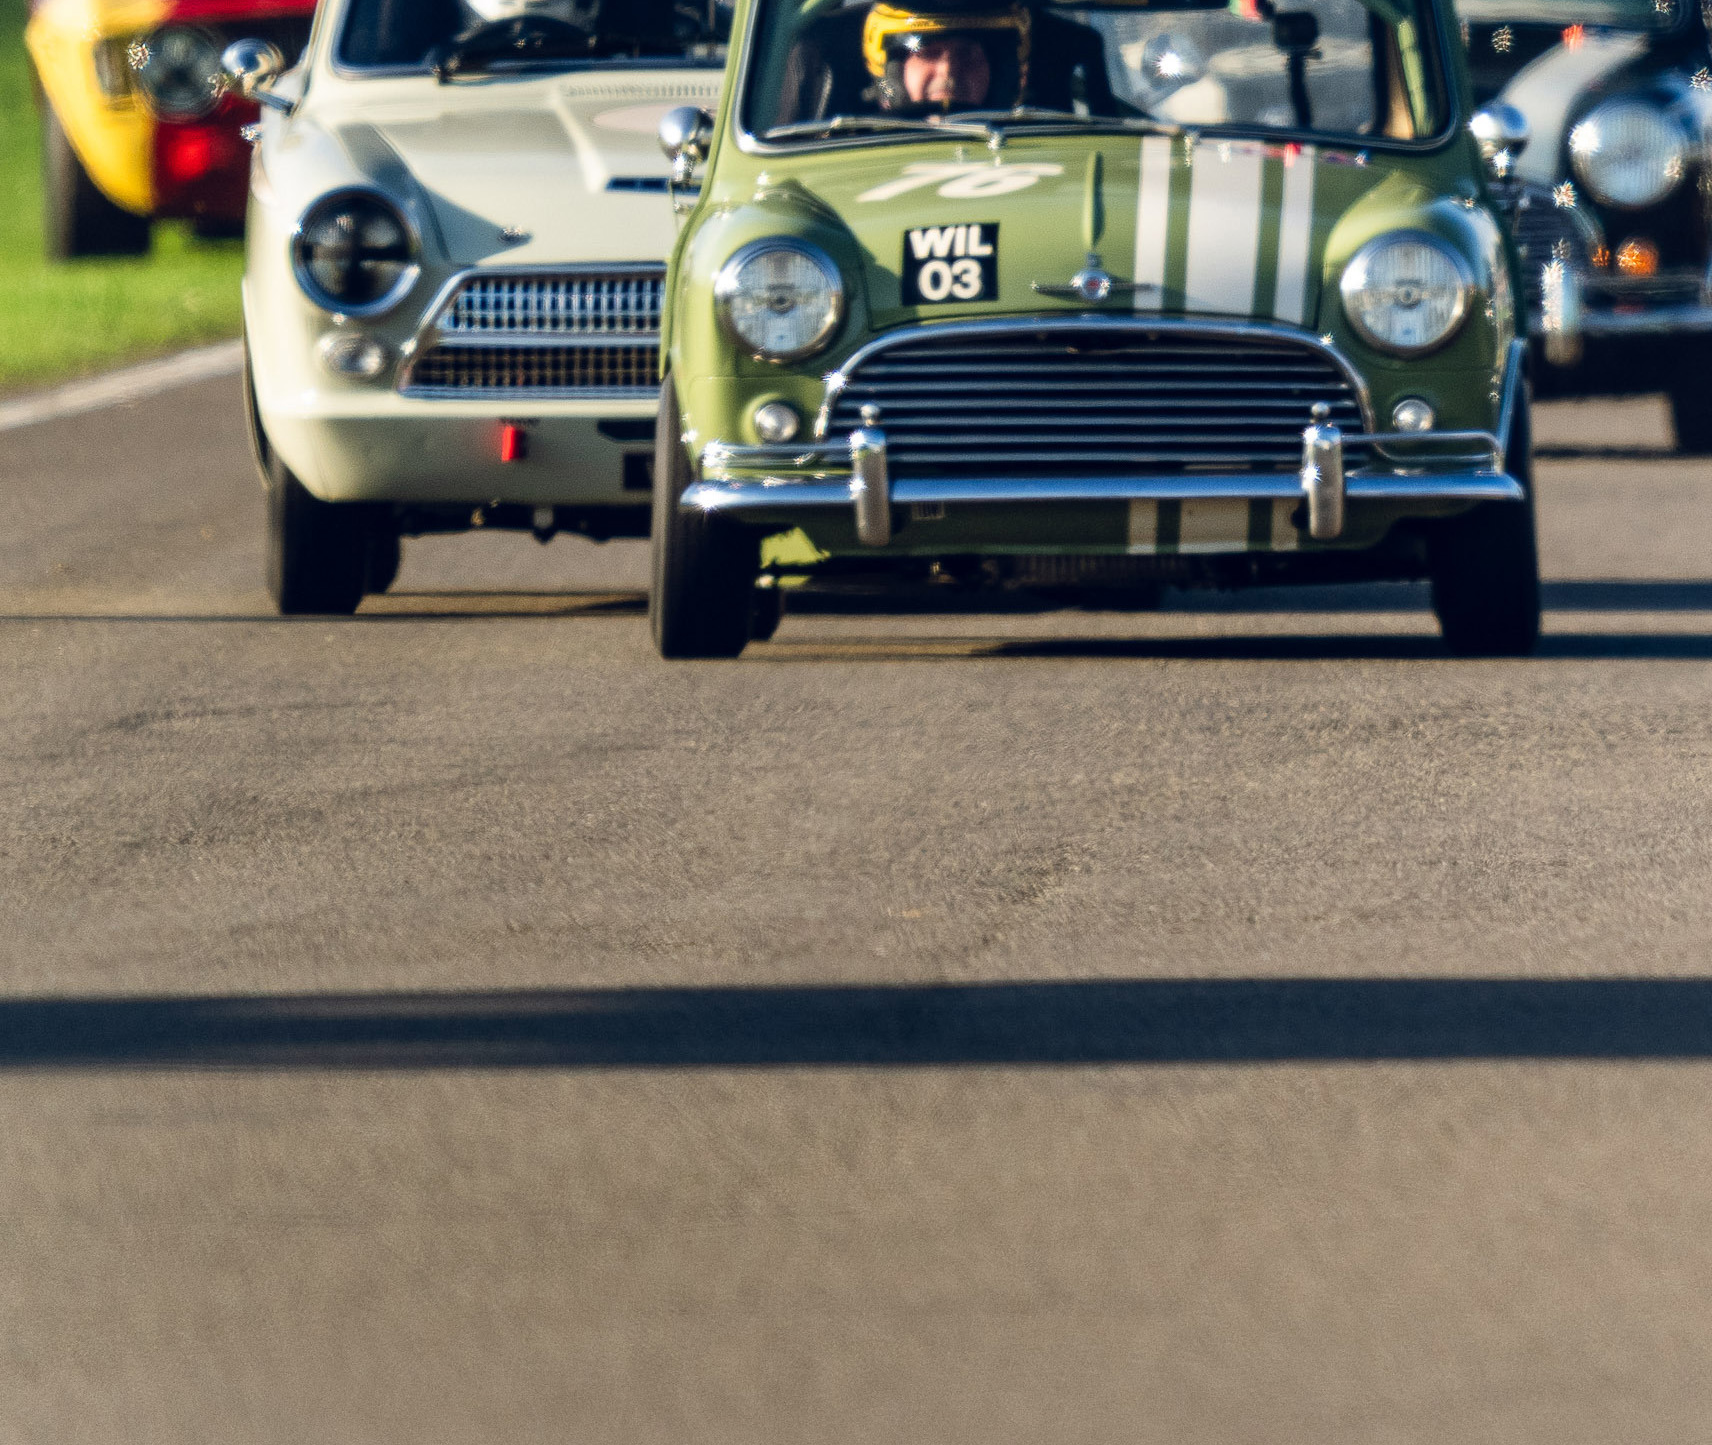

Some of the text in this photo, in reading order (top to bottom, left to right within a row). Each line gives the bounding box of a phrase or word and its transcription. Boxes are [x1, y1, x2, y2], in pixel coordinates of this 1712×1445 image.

[856, 162, 1064, 202] 76
[909, 225, 993, 260] WIL
[918, 258, 982, 301] 03
